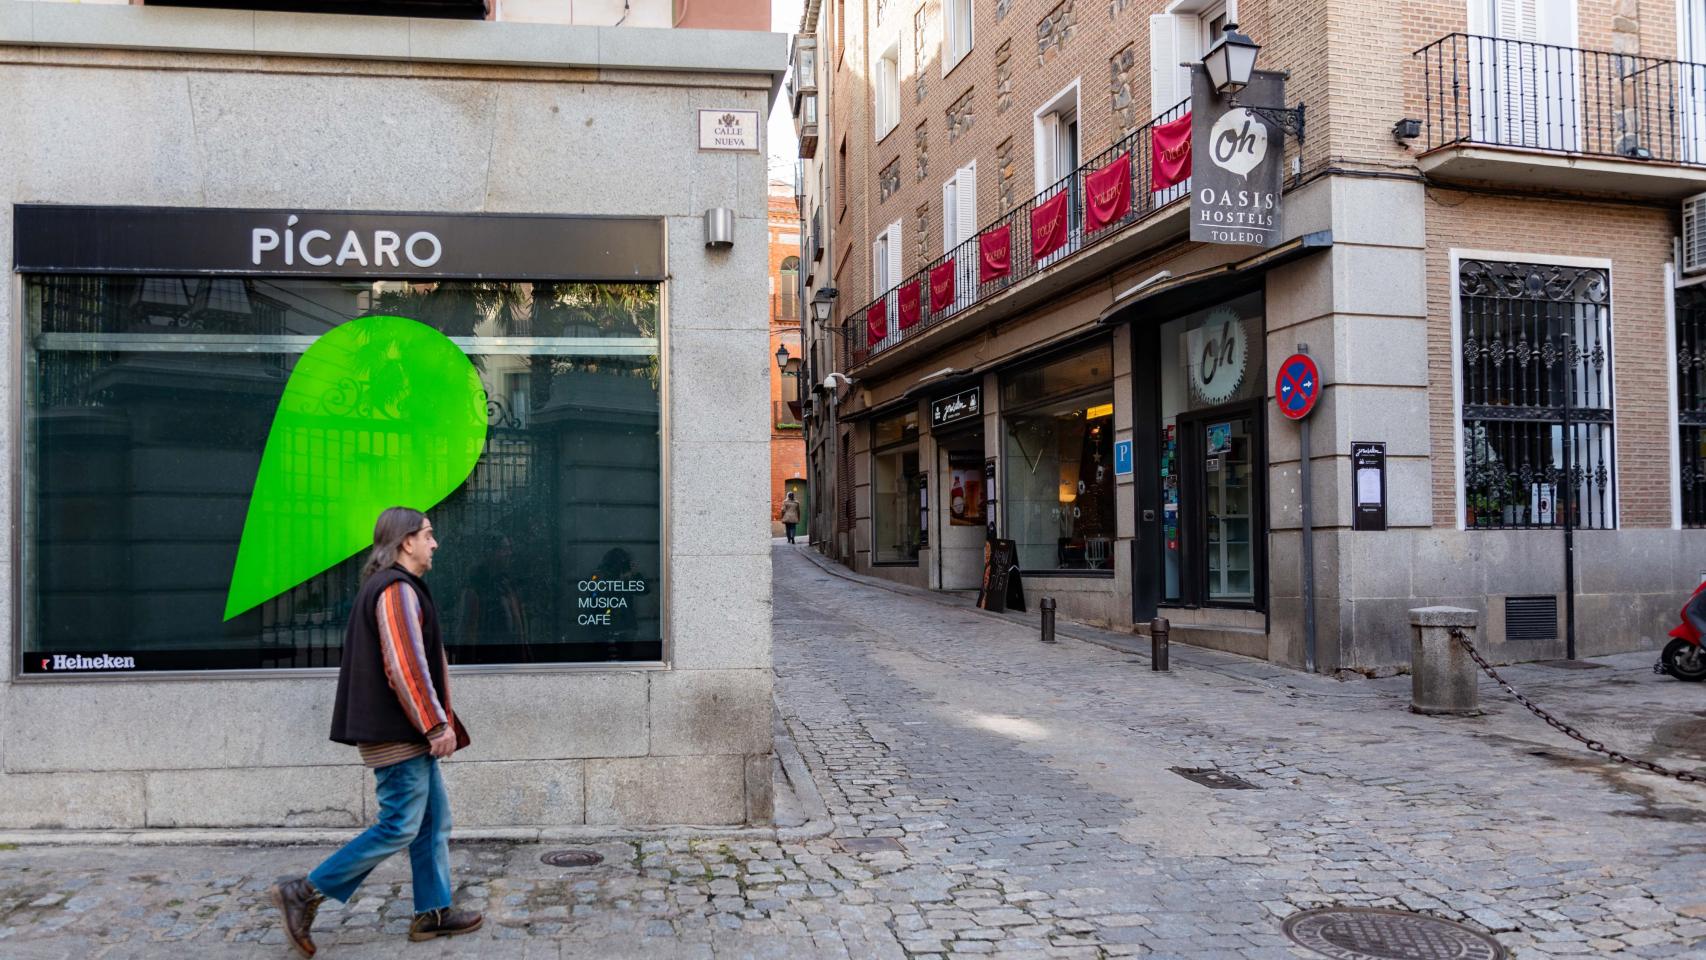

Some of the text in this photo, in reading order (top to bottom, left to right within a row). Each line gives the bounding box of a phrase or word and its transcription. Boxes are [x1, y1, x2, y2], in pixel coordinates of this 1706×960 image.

[714, 127, 743, 136] CALLE
[714, 138, 745, 146] NUEVA
[1160, 140, 1191, 163] TOLED
[1200, 188, 1273, 209] OASIS
[1200, 209, 1273, 226] HOSTELS
[252, 214, 442, 268] PÍCARO
[1211, 230, 1263, 244] TOLEDO
[1120, 445, 1128, 462] P
[577, 575, 645, 592] CÓCTELES
[578, 592, 628, 609] MÚSICA
[577, 609, 611, 625] CAFÉ
[52, 653, 136, 670] Heineken
